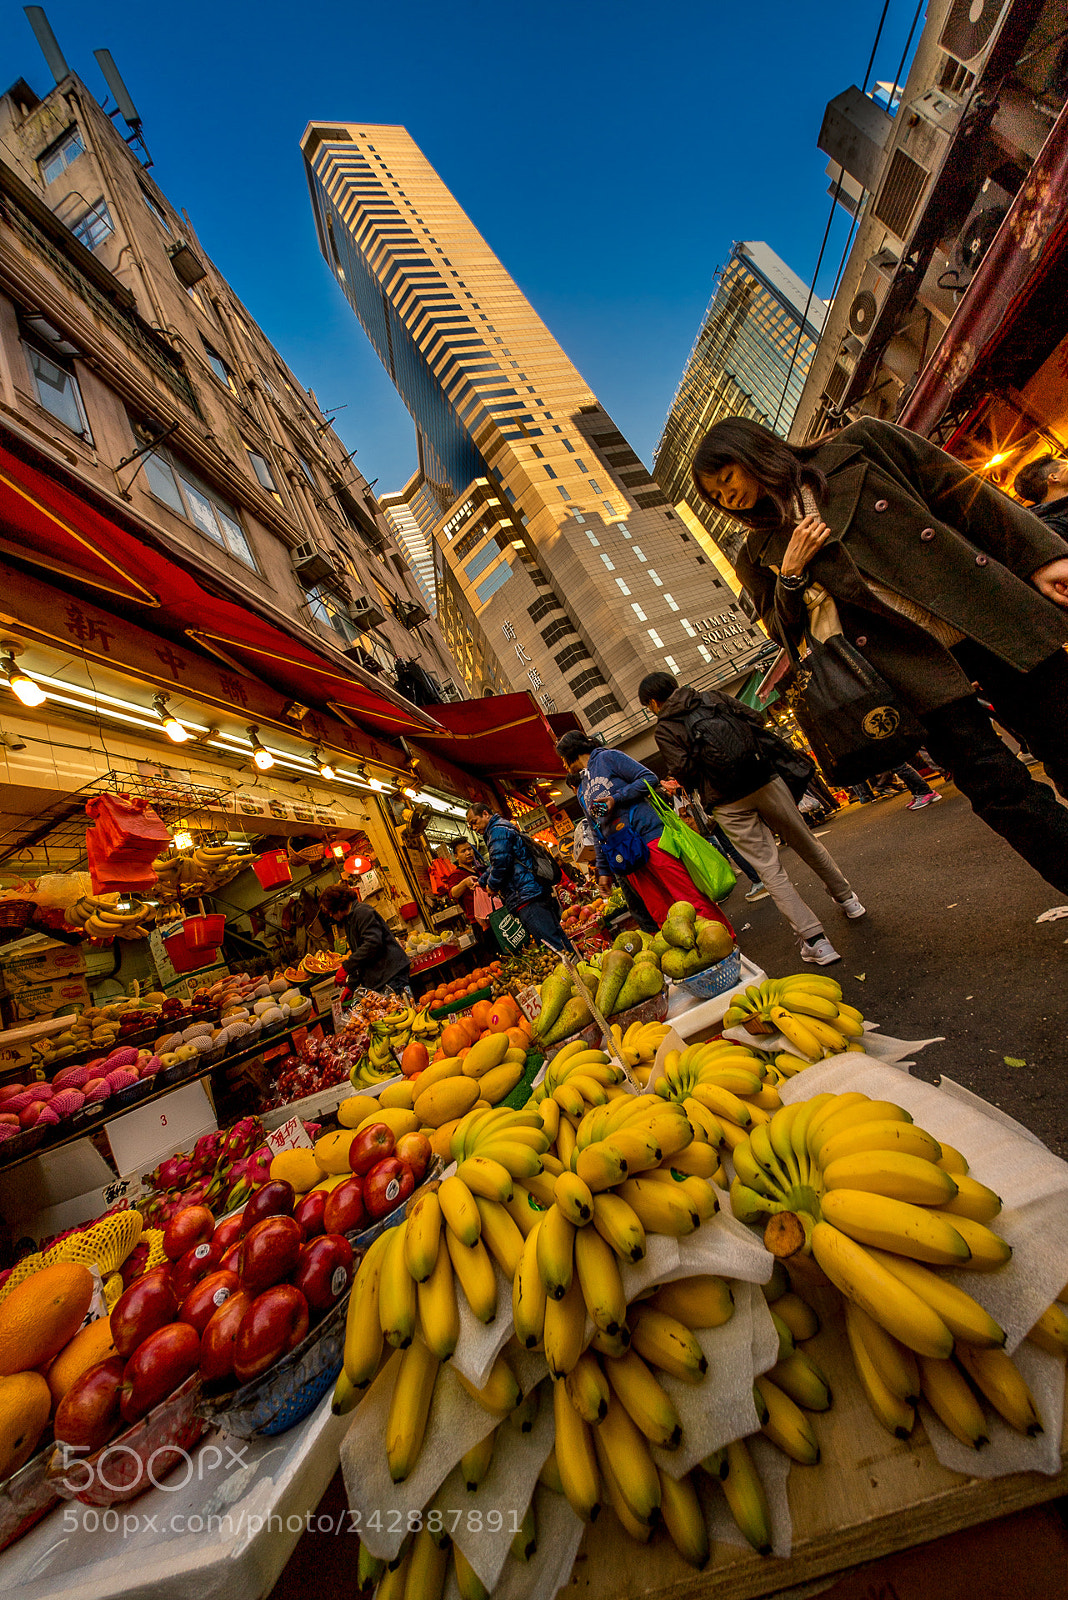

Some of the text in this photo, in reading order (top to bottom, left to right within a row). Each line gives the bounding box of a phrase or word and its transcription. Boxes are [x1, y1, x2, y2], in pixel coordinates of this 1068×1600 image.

[693, 610, 737, 633] TIMES
[701, 622, 746, 645] SQUARE
[501, 620, 559, 715] 時代廣場
[526, 997, 542, 1020] 25
[160, 1114, 168, 1126] 3
